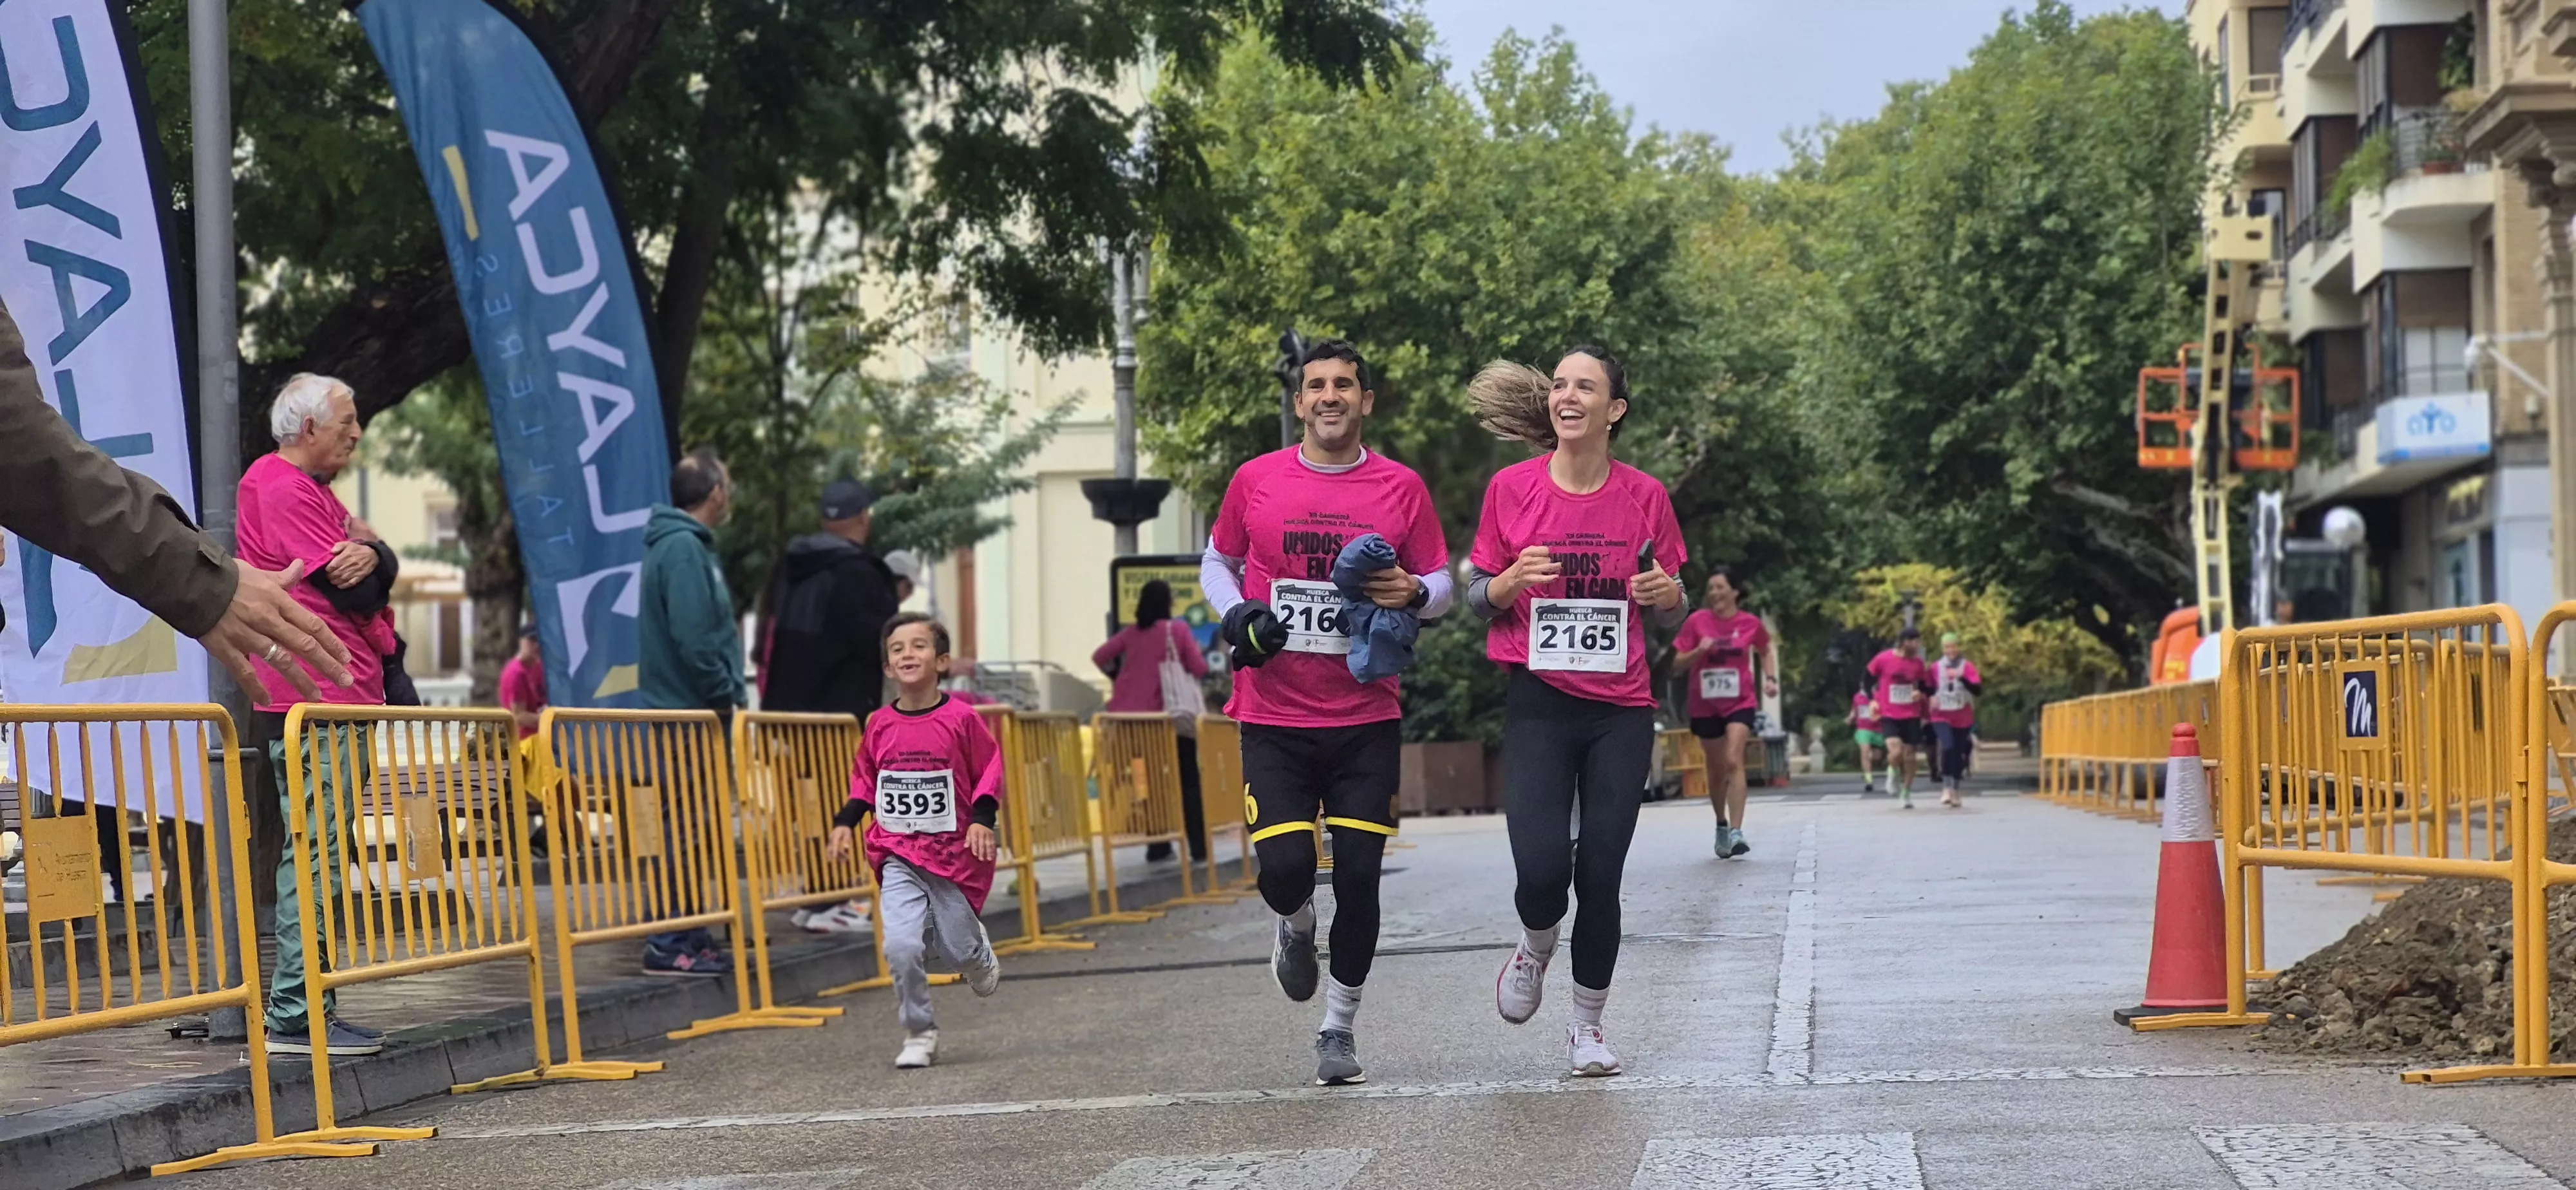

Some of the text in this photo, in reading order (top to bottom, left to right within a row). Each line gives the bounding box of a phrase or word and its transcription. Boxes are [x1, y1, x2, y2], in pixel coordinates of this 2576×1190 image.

[1283, 531, 1343, 556] UNIDOS
[1282, 592, 1312, 602] CONTRA
[1324, 595, 1341, 603] CÁN
[1279, 604, 1338, 632] 216
[1587, 612, 1616, 621] CÁNCER
[1540, 624, 1616, 650] 2165
[883, 791, 947, 816] 3593
